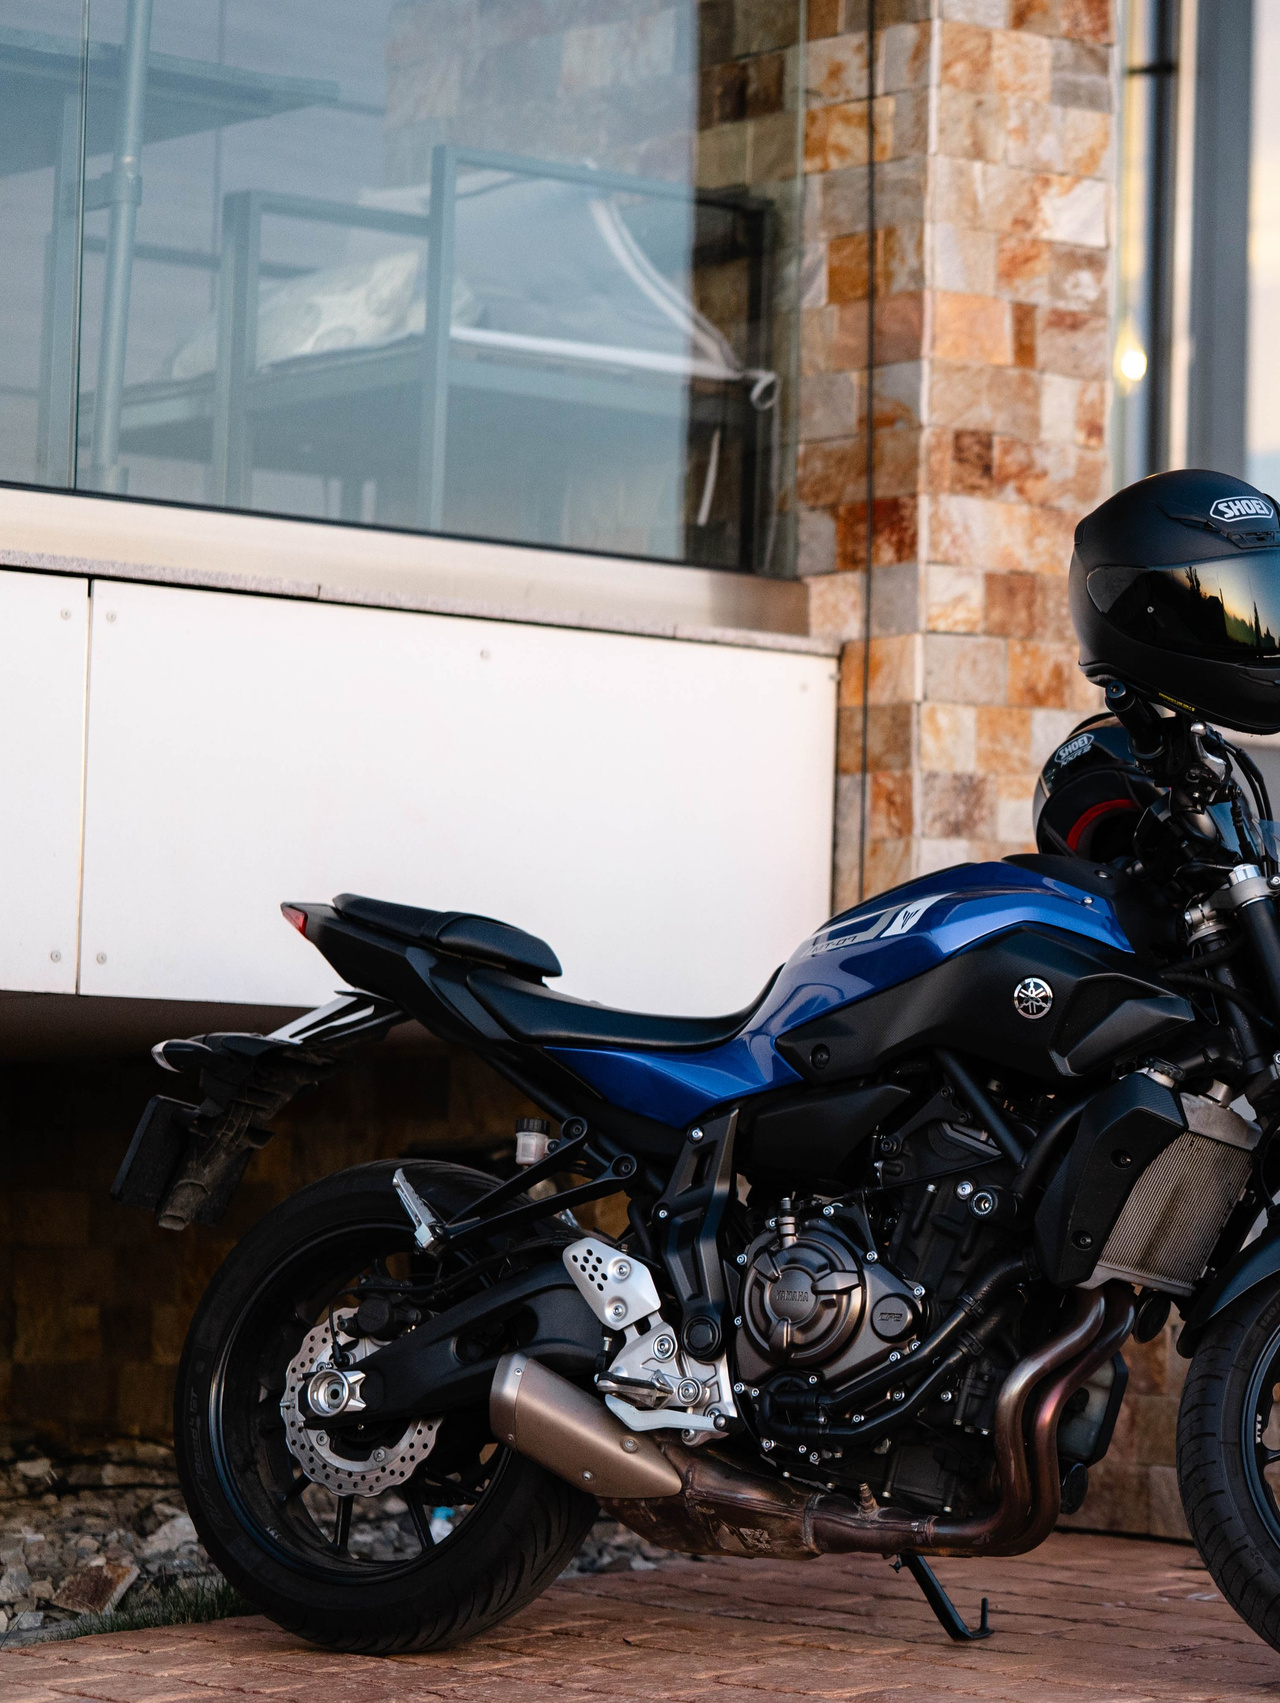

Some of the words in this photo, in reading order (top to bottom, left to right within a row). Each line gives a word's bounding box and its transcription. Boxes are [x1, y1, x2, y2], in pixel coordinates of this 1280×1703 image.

[1217, 500, 1270, 518] SHOEI
[1059, 736, 1088, 760] SHOEI
[811, 935, 857, 954] MT-07
[776, 1289, 809, 1302] YAMAHA
